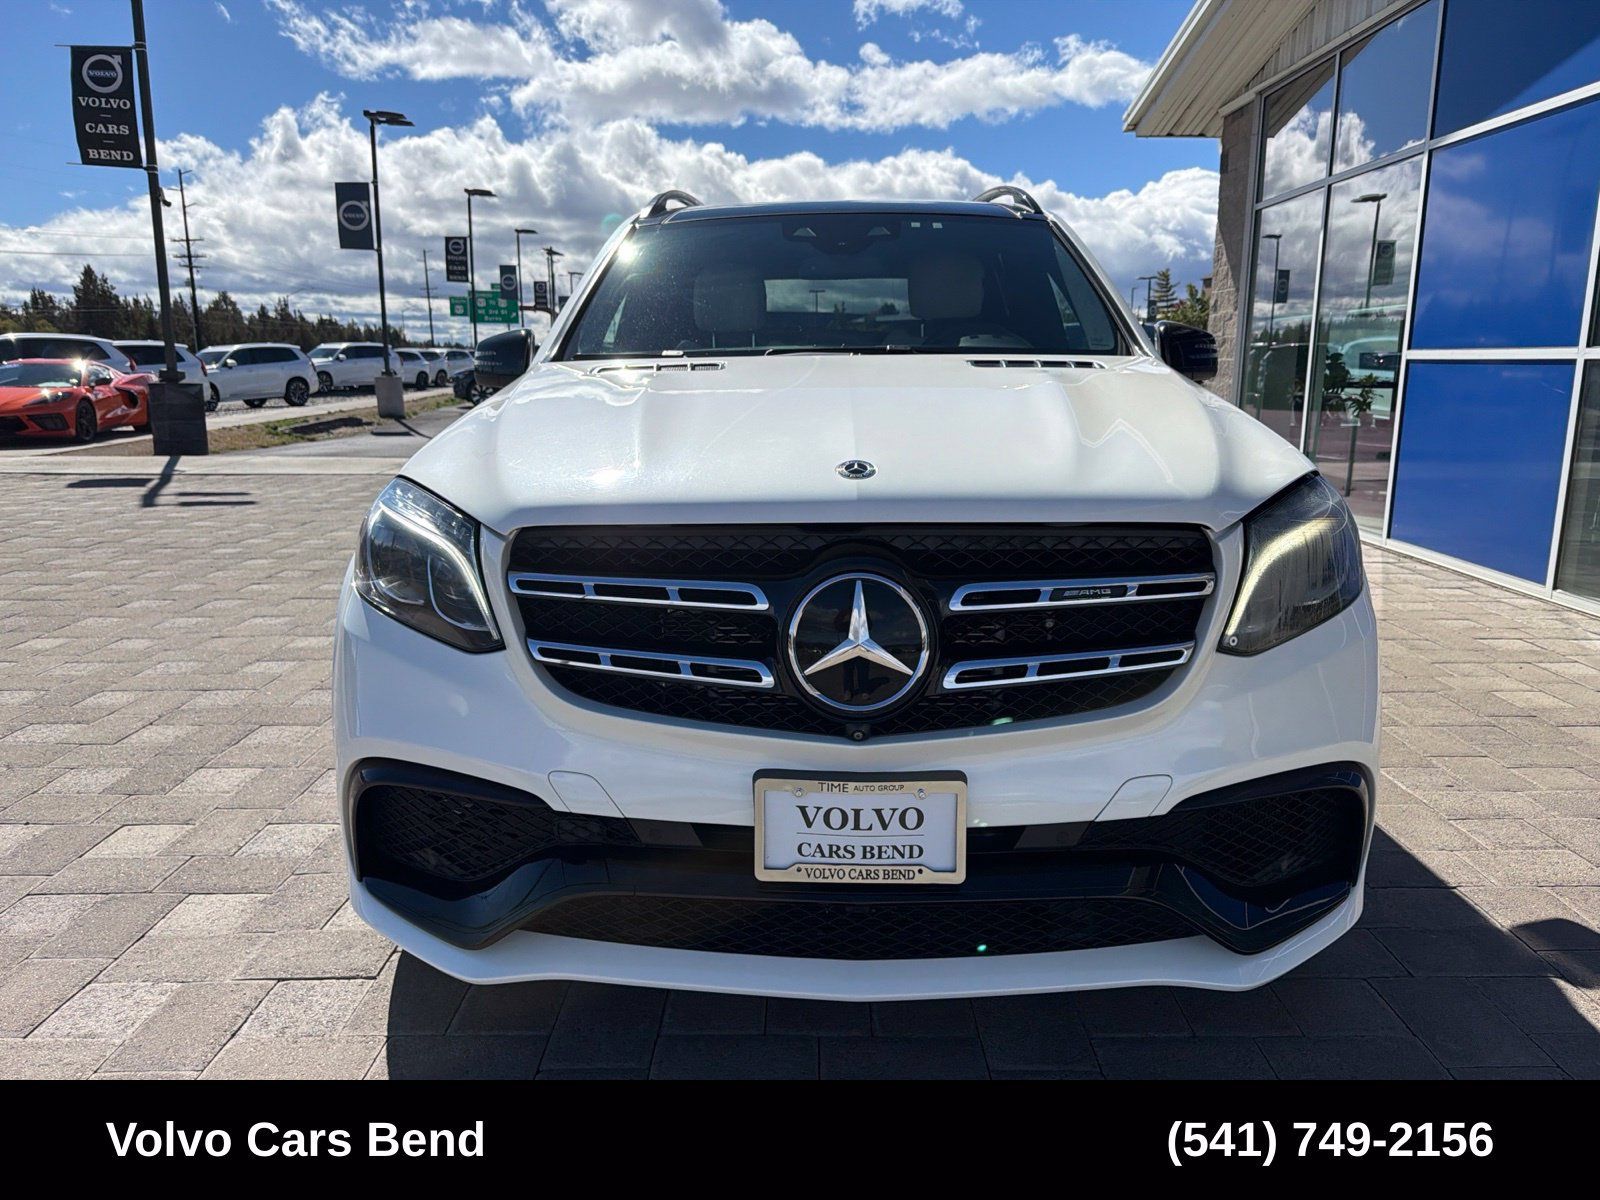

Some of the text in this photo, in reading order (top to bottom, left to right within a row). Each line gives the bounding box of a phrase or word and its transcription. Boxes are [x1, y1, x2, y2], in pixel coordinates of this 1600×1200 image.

[88, 69, 117, 77] VOLVO
[78, 96, 131, 110] VOLVO
[85, 122, 130, 135] CARS
[87, 148, 134, 161] BEND
[817, 781, 905, 793] TIME AUTO GROUP
[795, 804, 925, 831] VOLVO
[797, 842, 924, 860] CARS BEND
[805, 867, 916, 881] VOLVO CARS BEND
